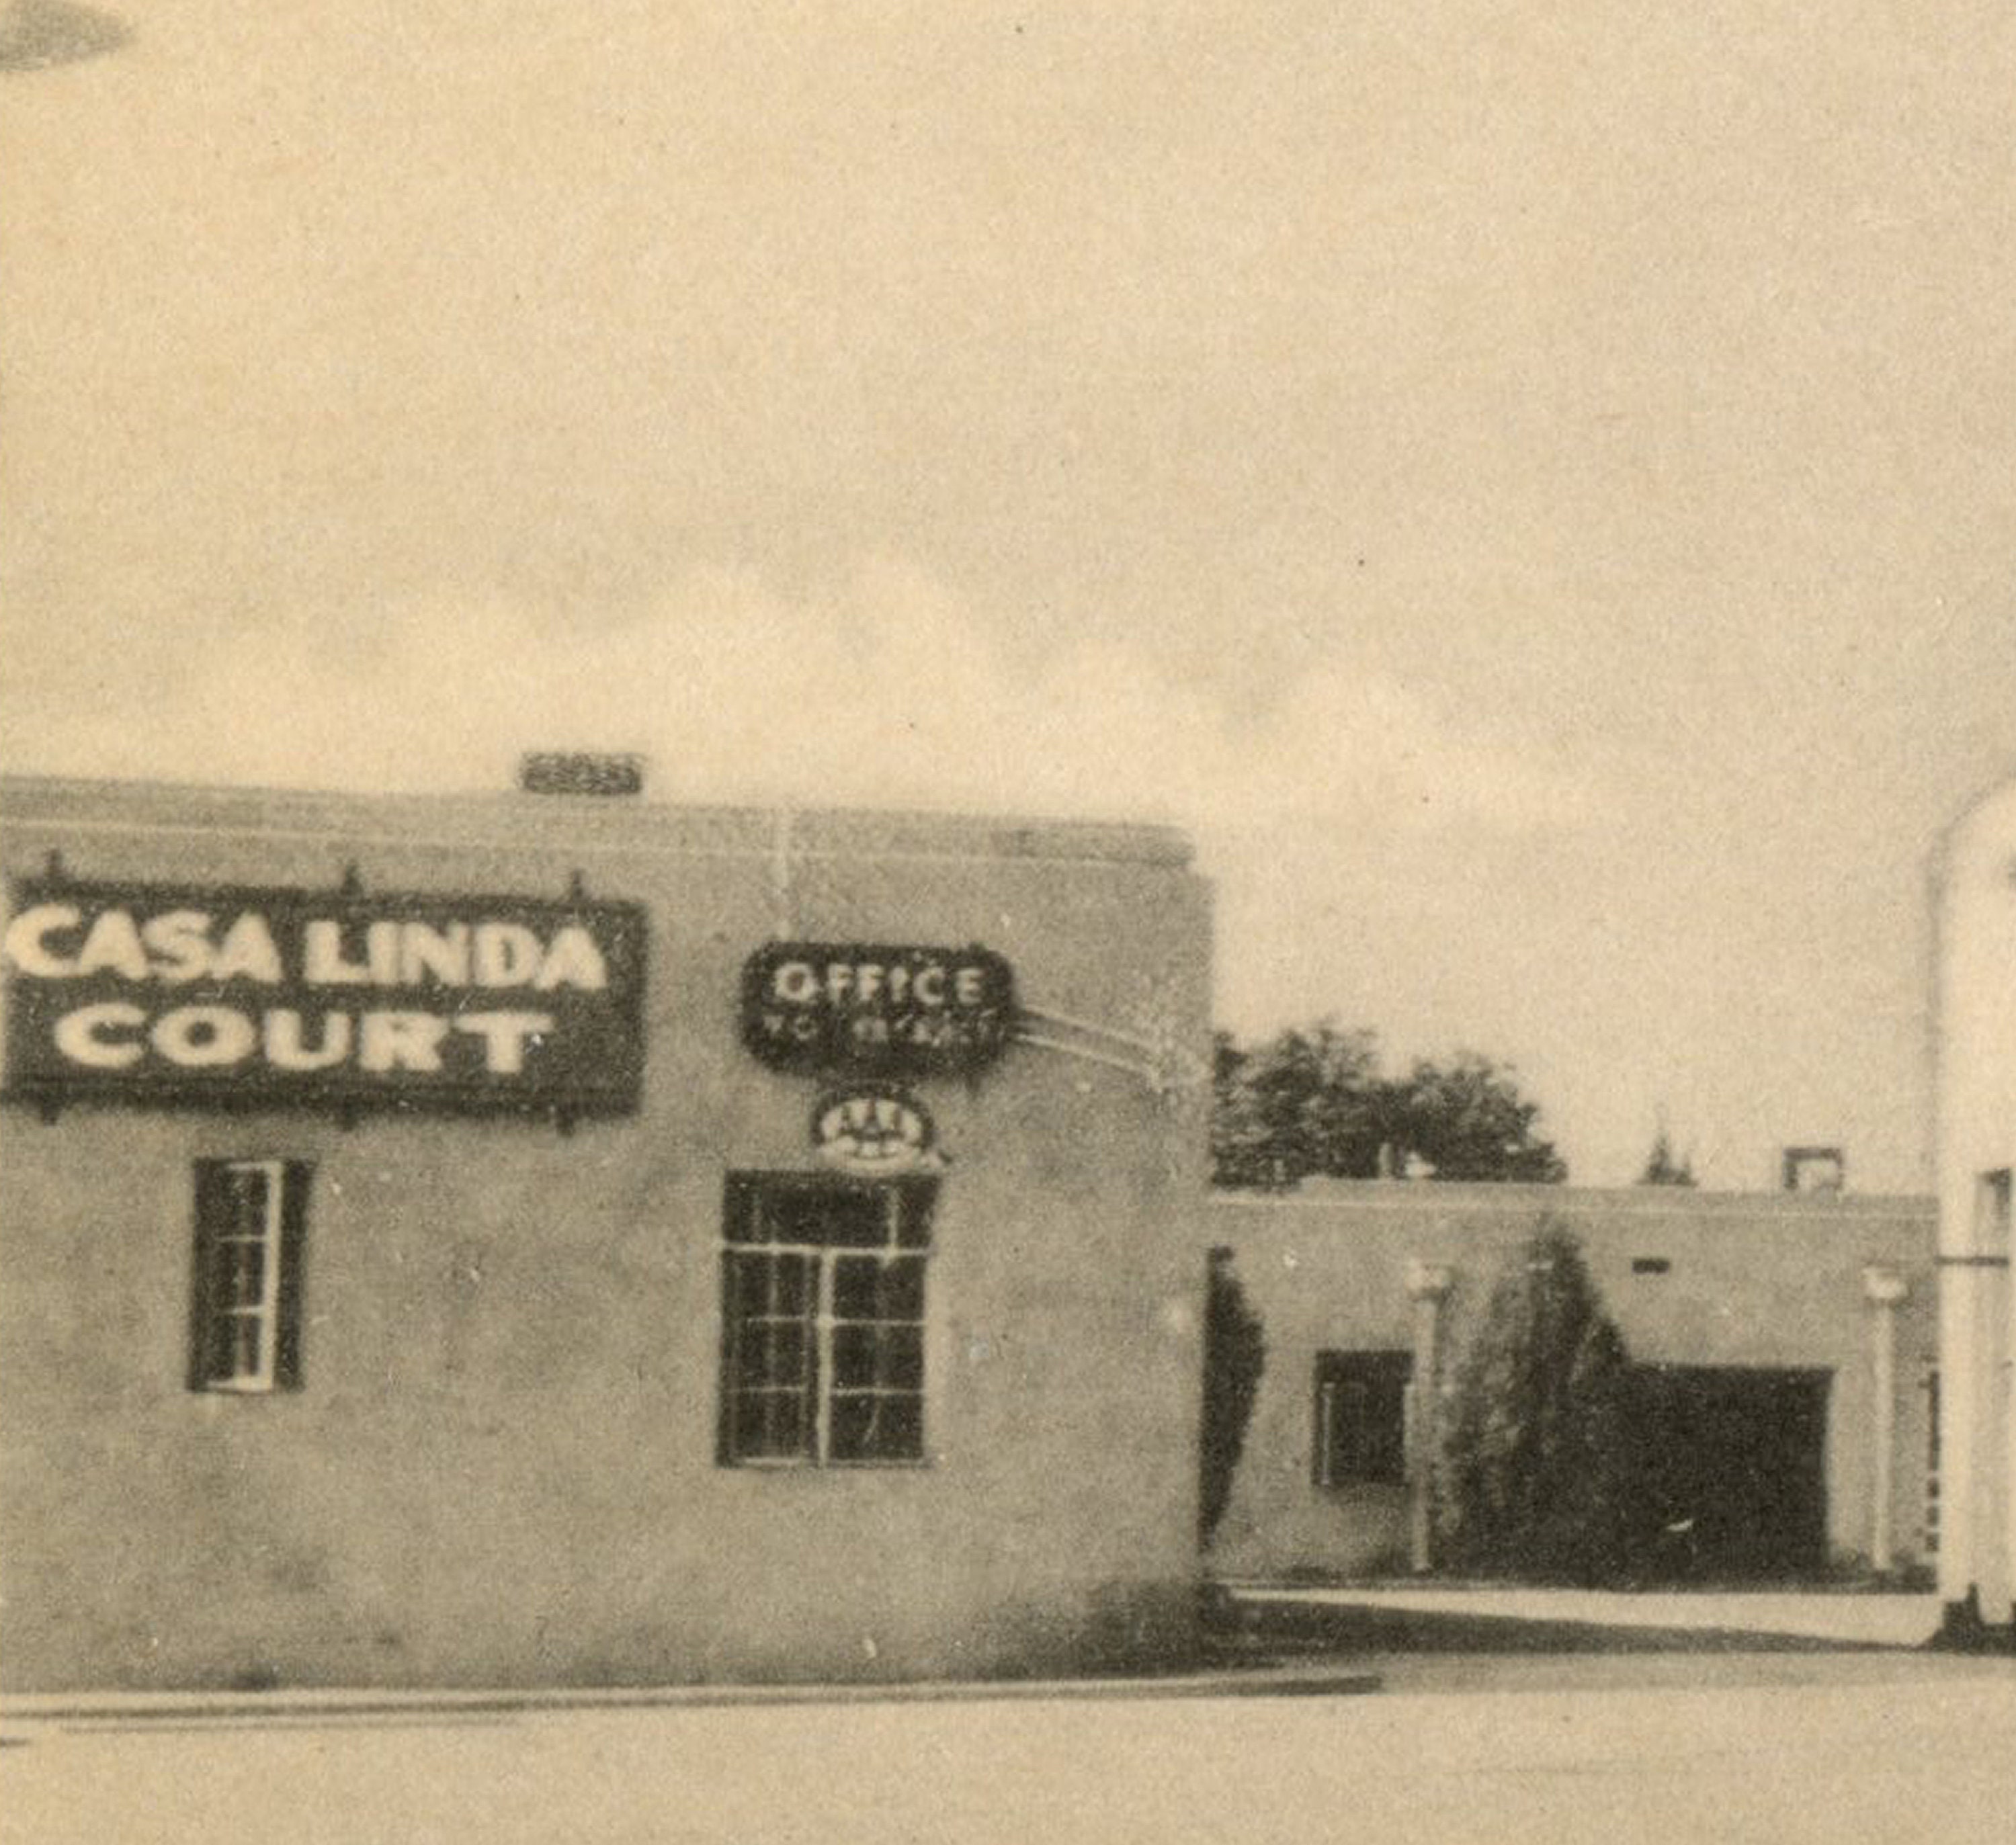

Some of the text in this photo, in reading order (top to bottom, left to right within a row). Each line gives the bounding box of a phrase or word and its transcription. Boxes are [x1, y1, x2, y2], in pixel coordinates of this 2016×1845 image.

[3, 903, 607, 990] CASA LINDA
[773, 961, 984, 1006] OFFICE
[54, 1002, 555, 1073] COURT
